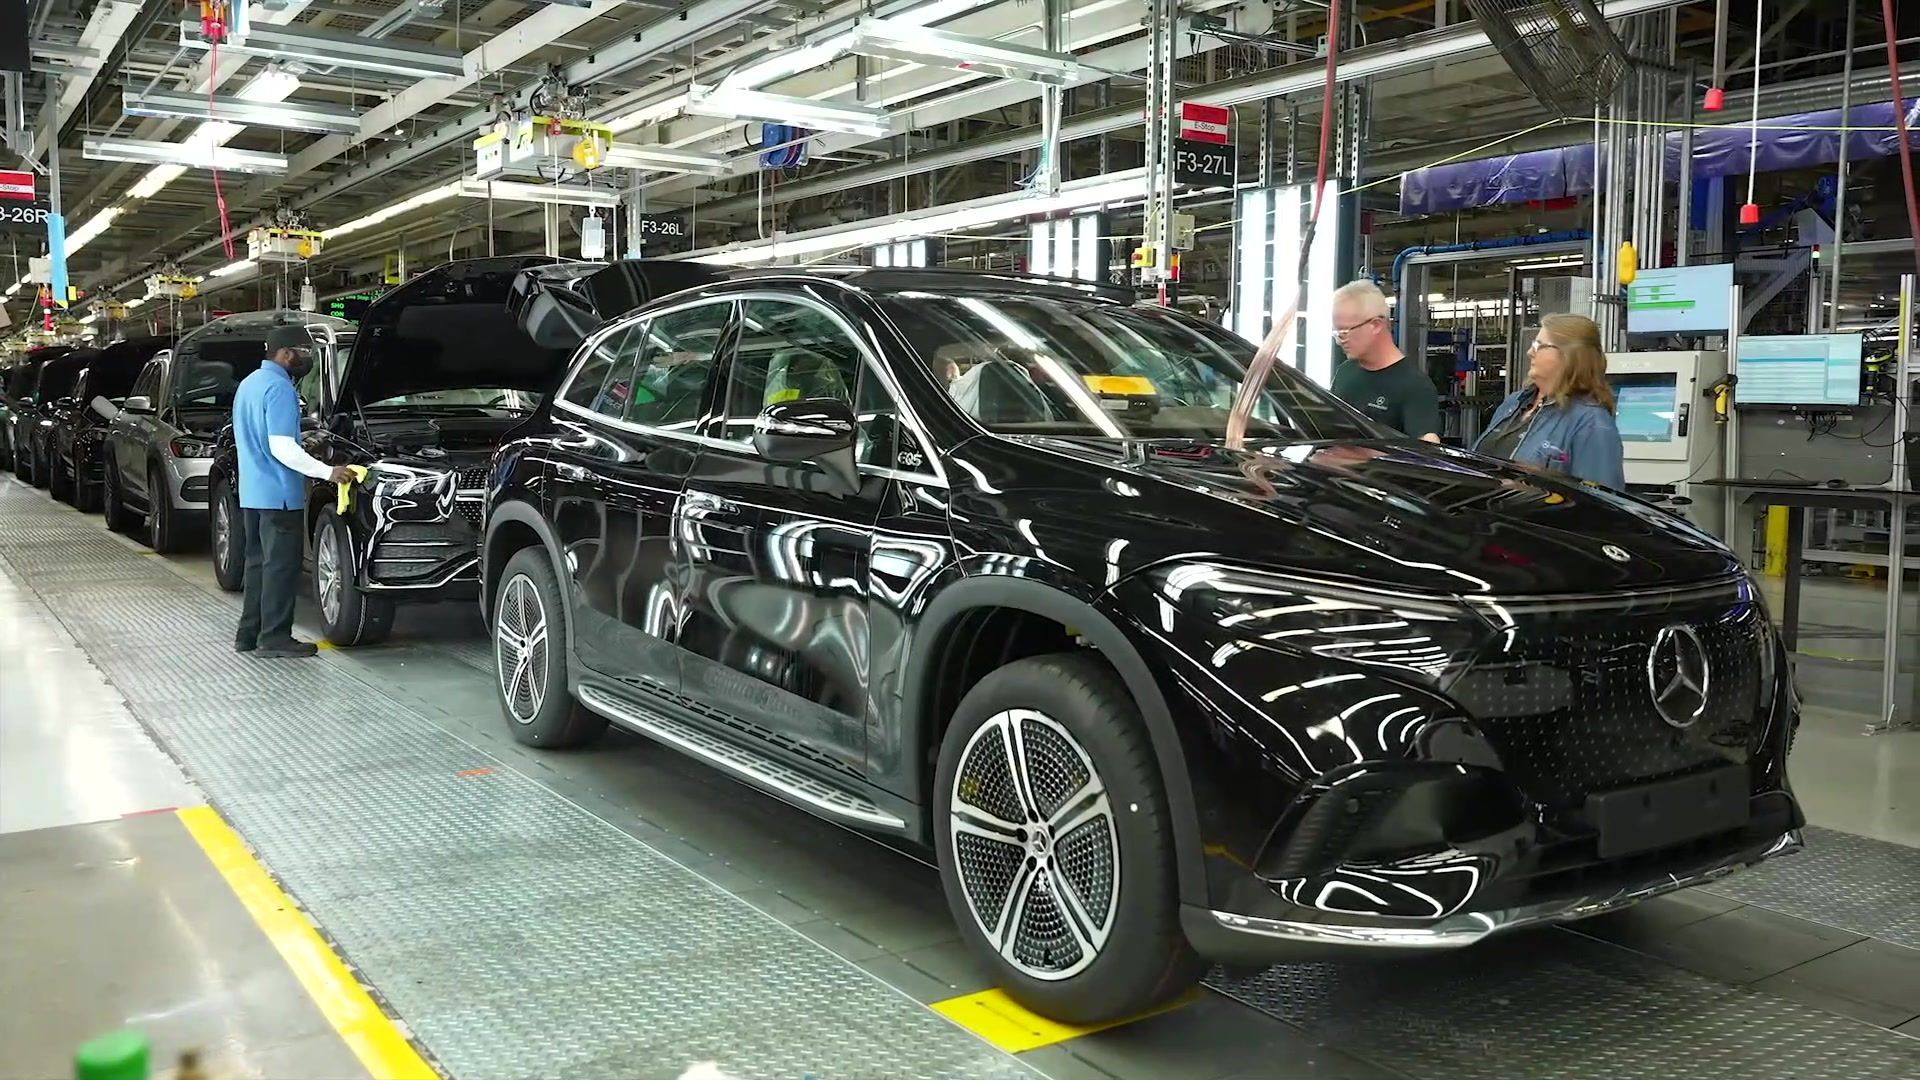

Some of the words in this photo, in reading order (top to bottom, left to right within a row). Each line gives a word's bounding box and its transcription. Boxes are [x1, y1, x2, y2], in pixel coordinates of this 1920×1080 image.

[1194, 121, 1215, 132] E-Stop
[1177, 151, 1232, 176] F3-27L
[641, 220, 683, 236] F3-26L
